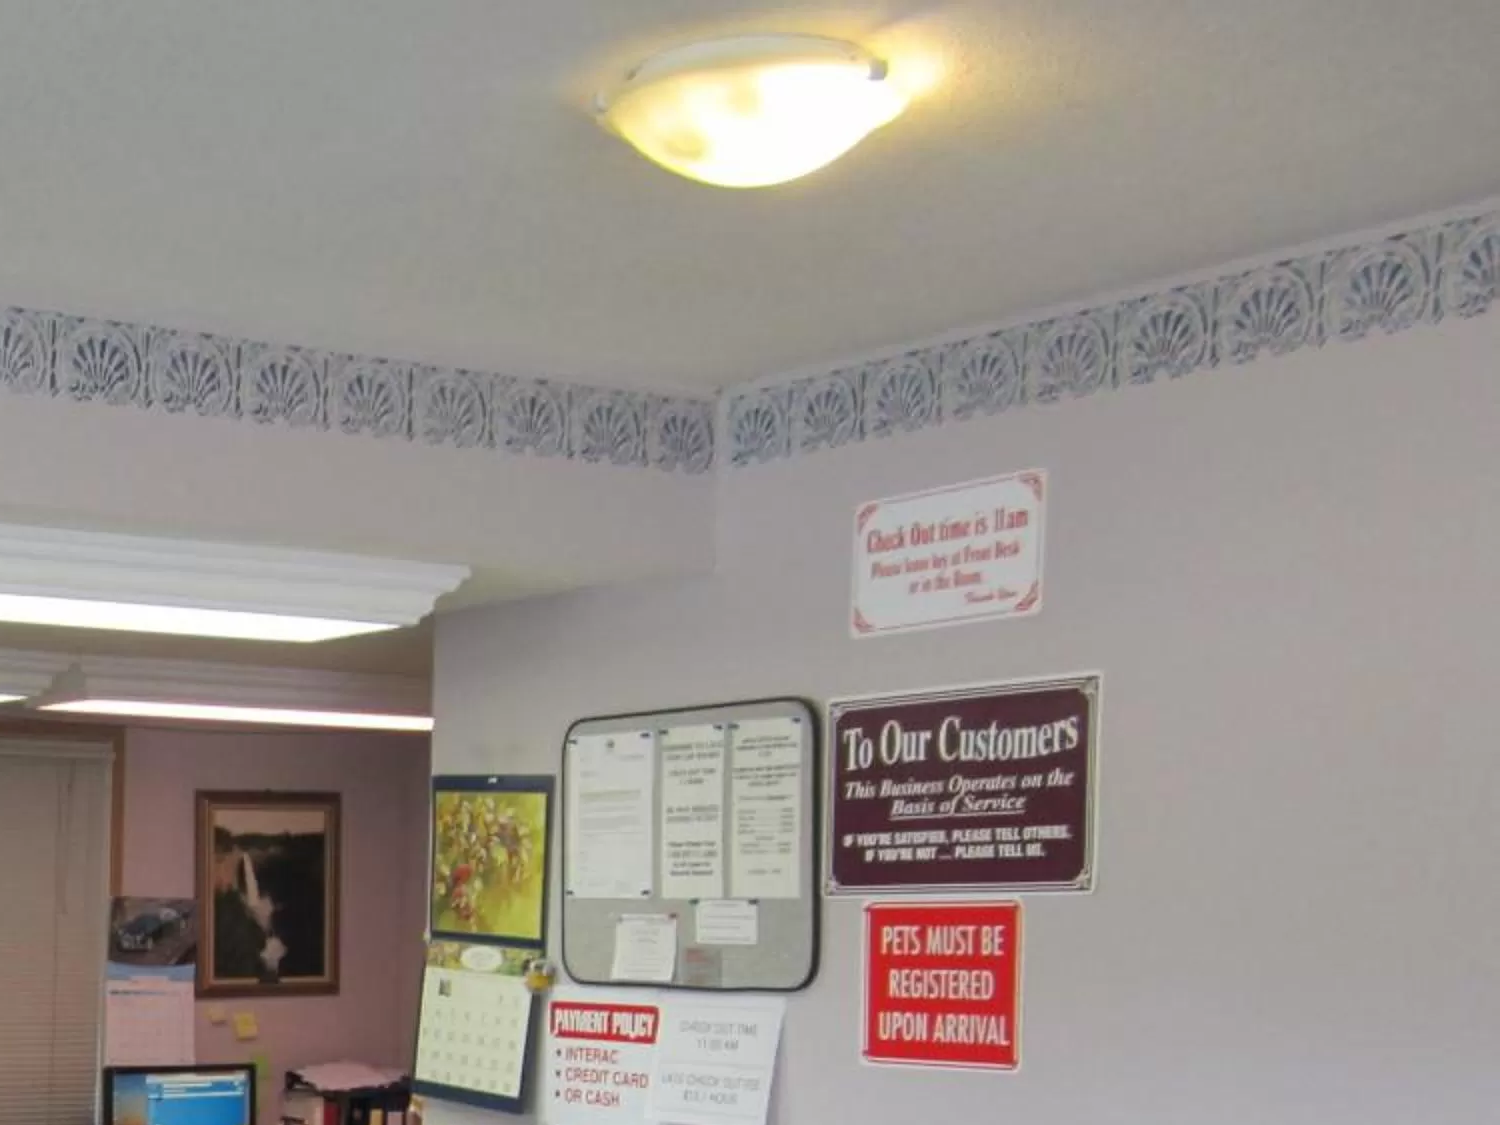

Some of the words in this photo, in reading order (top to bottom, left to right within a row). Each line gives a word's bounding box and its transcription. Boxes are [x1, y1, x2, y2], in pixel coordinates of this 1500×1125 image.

[910, 521, 934, 545] Out
[974, 511, 989, 535] is
[843, 726, 873, 771] To
[880, 720, 932, 765] Our
[939, 715, 1079, 762] Customers
[845, 780, 876, 799] This
[879, 778, 944, 798] Business
[948, 774, 1017, 798] Operates
[1021, 774, 1042, 788] on
[1047, 768, 1074, 787] the
[891, 799, 934, 815] Basis
[939, 794, 963, 816] of
[962, 793, 1026, 812] Service
[952, 828, 993, 843] PLEASE
[995, 827, 1020, 841] TELL
[954, 845, 995, 859] PLEASE
[997, 844, 1022, 858] TELL
[880, 925, 921, 956] PETS
[925, 925, 977, 956] MUST
[980, 925, 1006, 957] BE
[888, 968, 996, 1000] REGISTERED
[554, 1009, 609, 1035] PAYMENT
[611, 1011, 655, 1038] POLICY
[877, 1011, 930, 1042] UPON
[932, 1013, 1010, 1046] ARRIVAL
[565, 1048, 618, 1064] INTERAC
[565, 1067, 610, 1083] CREDIT
[613, 1071, 649, 1089] CARD
[564, 1087, 582, 1103] OR
[586, 1090, 620, 1107] CASH
